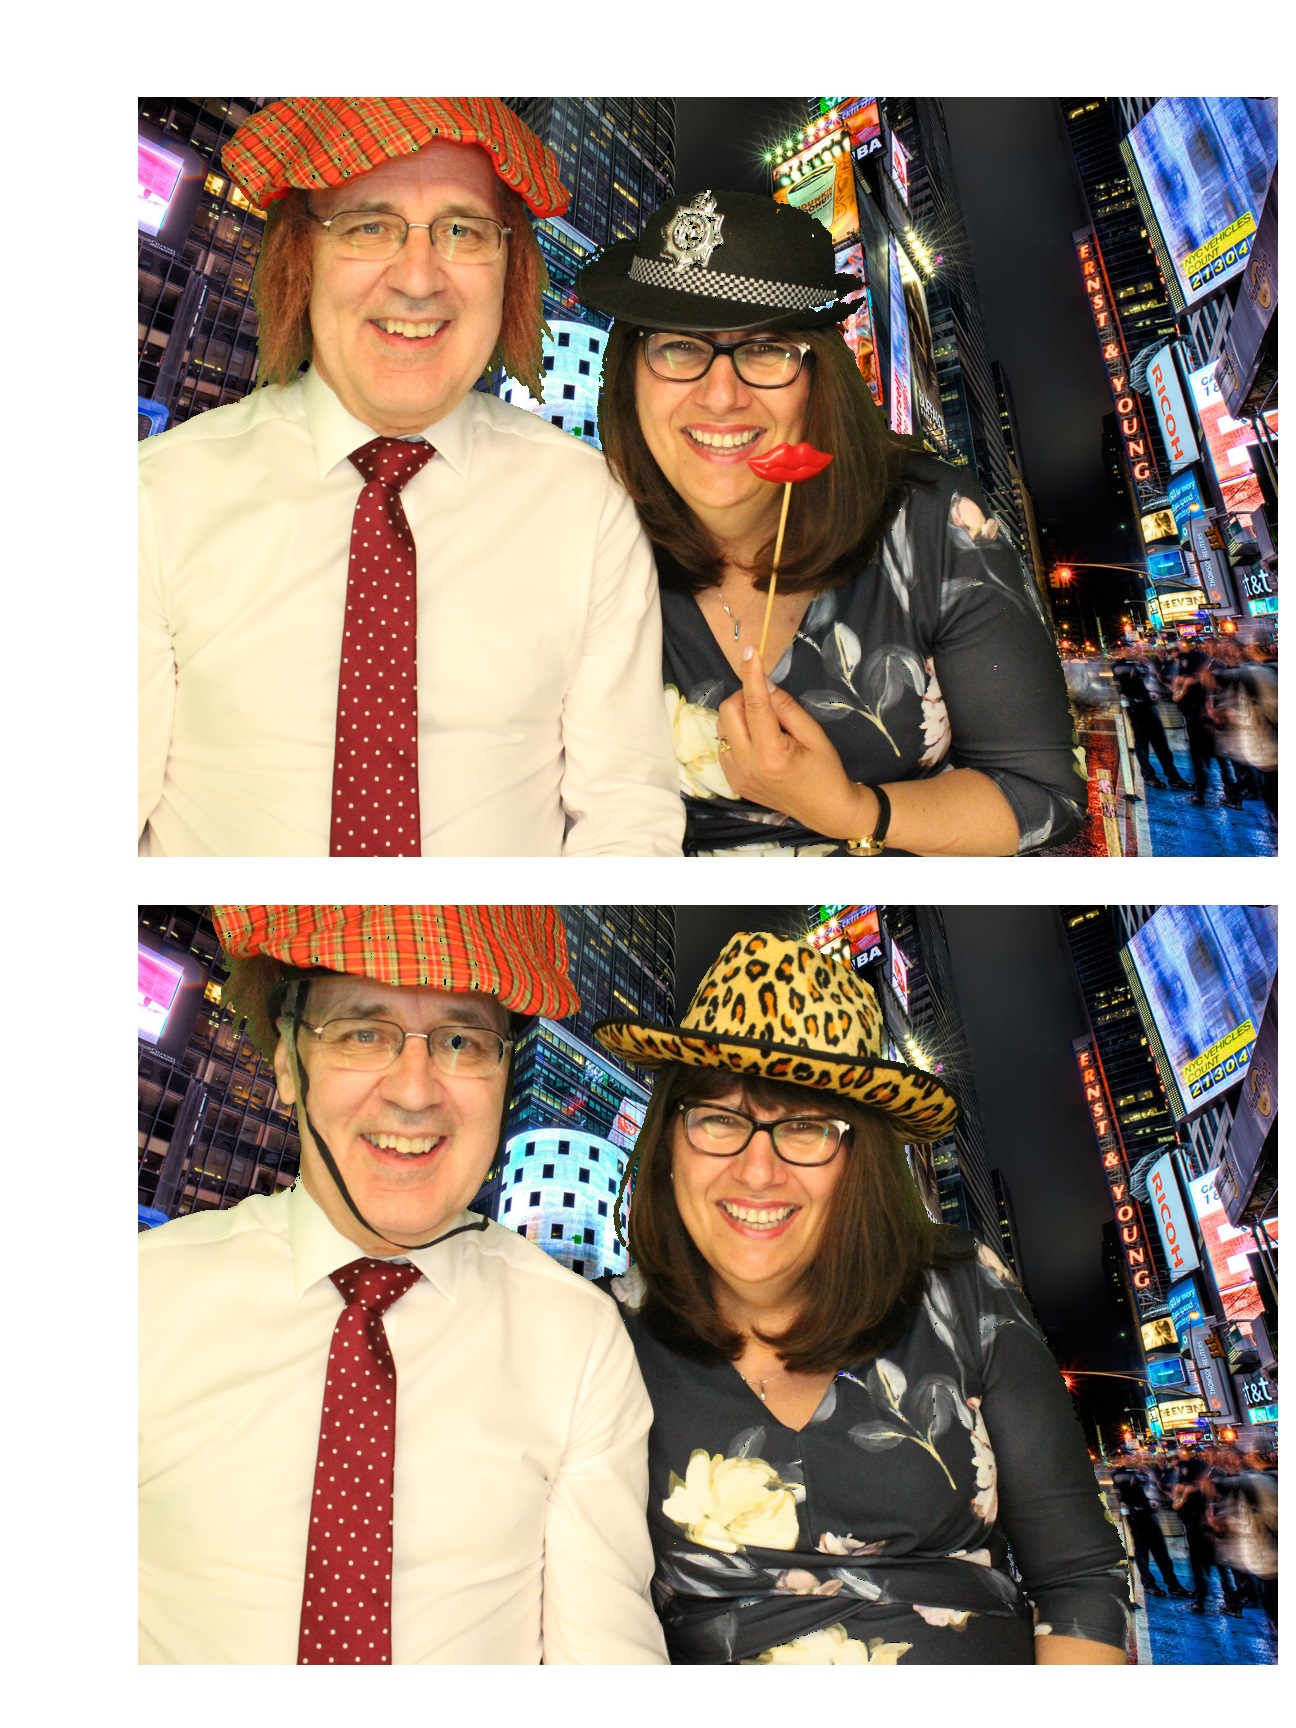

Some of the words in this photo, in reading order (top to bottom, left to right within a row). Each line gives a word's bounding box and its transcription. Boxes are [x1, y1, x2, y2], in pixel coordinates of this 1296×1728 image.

[1184, 247, 1204, 267] NYC
[1203, 213, 1251, 251] VEHICLES
[1187, 246, 1220, 275] COUNT
[1079, 243, 1108, 328] ERNST
[1104, 343, 1119, 359] &
[1112, 376, 1150, 480] YOUNG
[1151, 363, 1184, 460] RICOH
[1198, 532, 1208, 559] REUTERS
[1184, 1055, 1204, 1075] NYC
[1203, 1021, 1251, 1059] VEHICLES
[1187, 1054, 1220, 1083] COUNT
[1079, 1051, 1108, 1136] ERNST
[1104, 1151, 1119, 1167] &
[1112, 1184, 1150, 1288] YOUNG
[1151, 1171, 1184, 1268] RICOH
[1198, 1340, 1208, 1367] REUTERS
